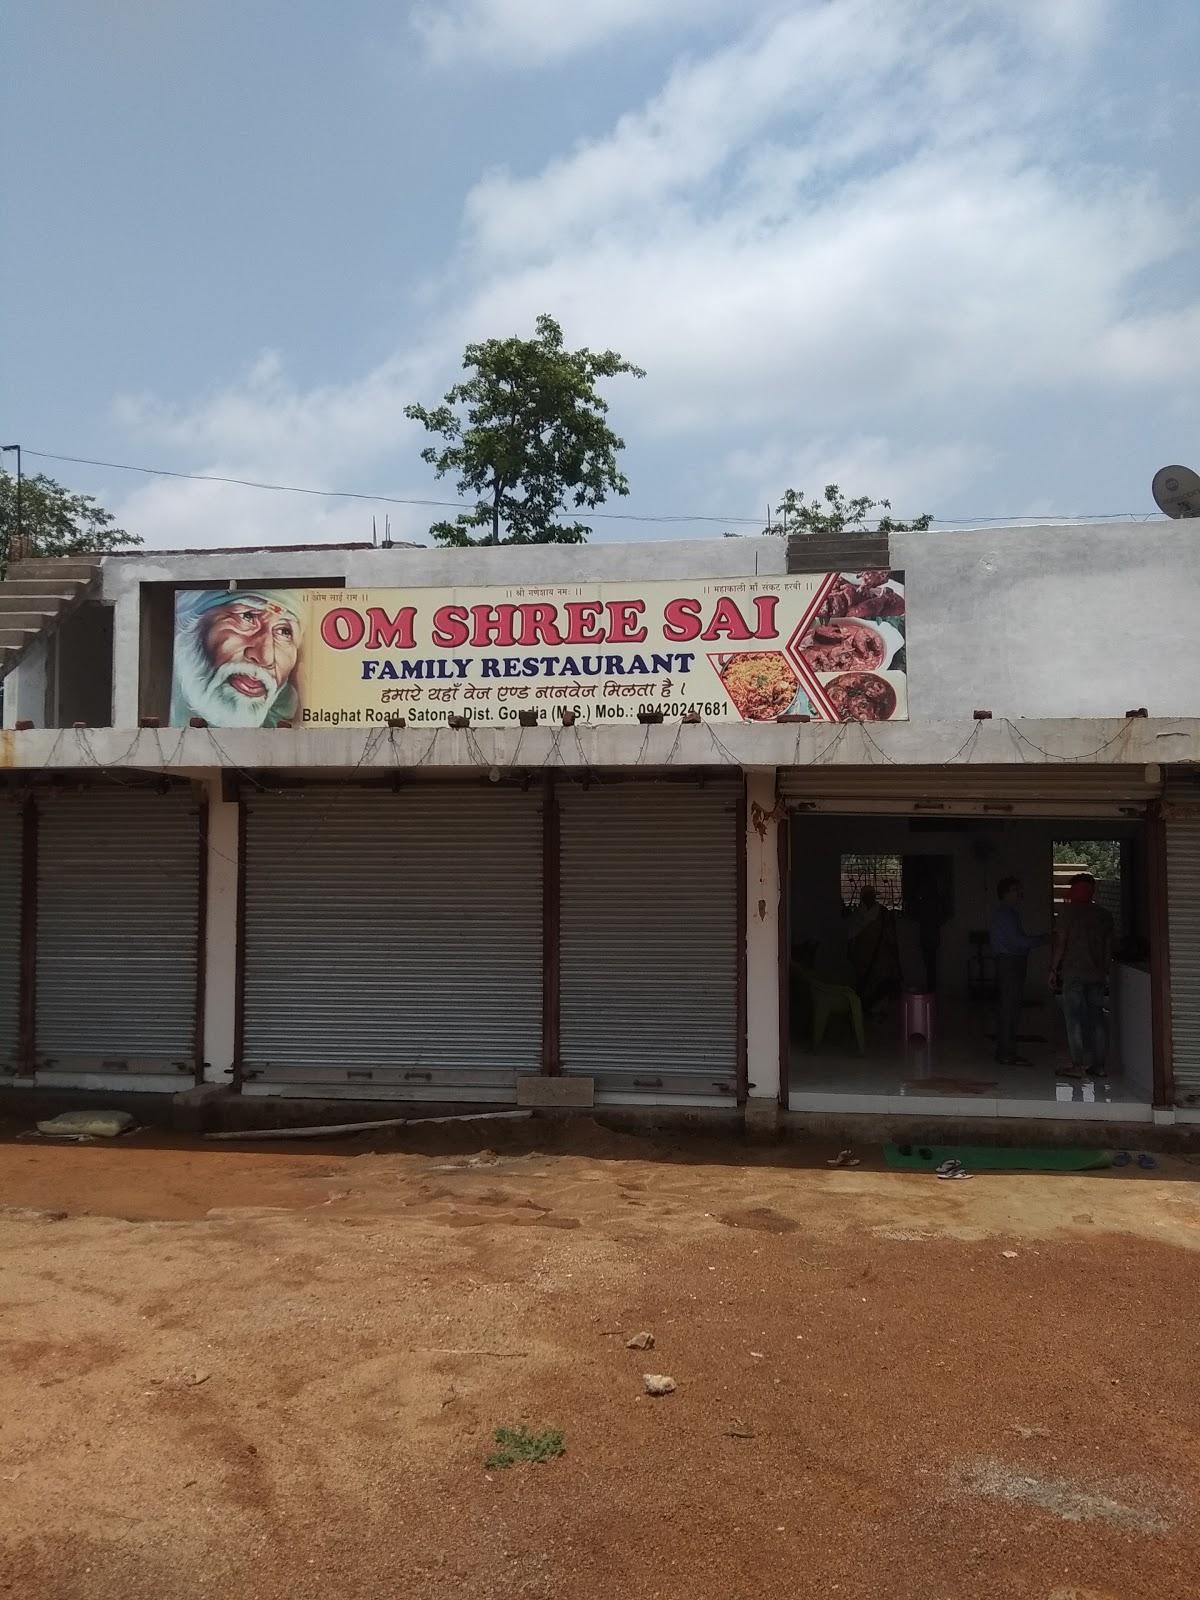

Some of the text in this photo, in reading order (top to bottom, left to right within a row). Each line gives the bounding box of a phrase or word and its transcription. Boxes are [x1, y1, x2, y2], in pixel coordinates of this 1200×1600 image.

[515, 587, 525, 597] श्री
[528, 586, 554, 597] गणेशाय
[714, 583, 746, 593] महाकाली
[320, 595, 780, 650] OM SHREE SAI
[361, 653, 695, 679] FAMILY RESTAURANT
[381, 684, 424, 704] हमारे
[428, 682, 462, 702] यहाँ
[463, 683, 493, 700] वेज
[497, 686, 531, 702] एण्ड
[535, 681, 598, 699] नानवेज
[603, 680, 657, 698] मिलता
[660, 678, 674, 698] है
[302, 708, 361, 725] Balaghat
[464, 706, 493, 721] Dist.
[551, 704, 591, 723] (MS.)
[638, 701, 728, 717] 09420247681
